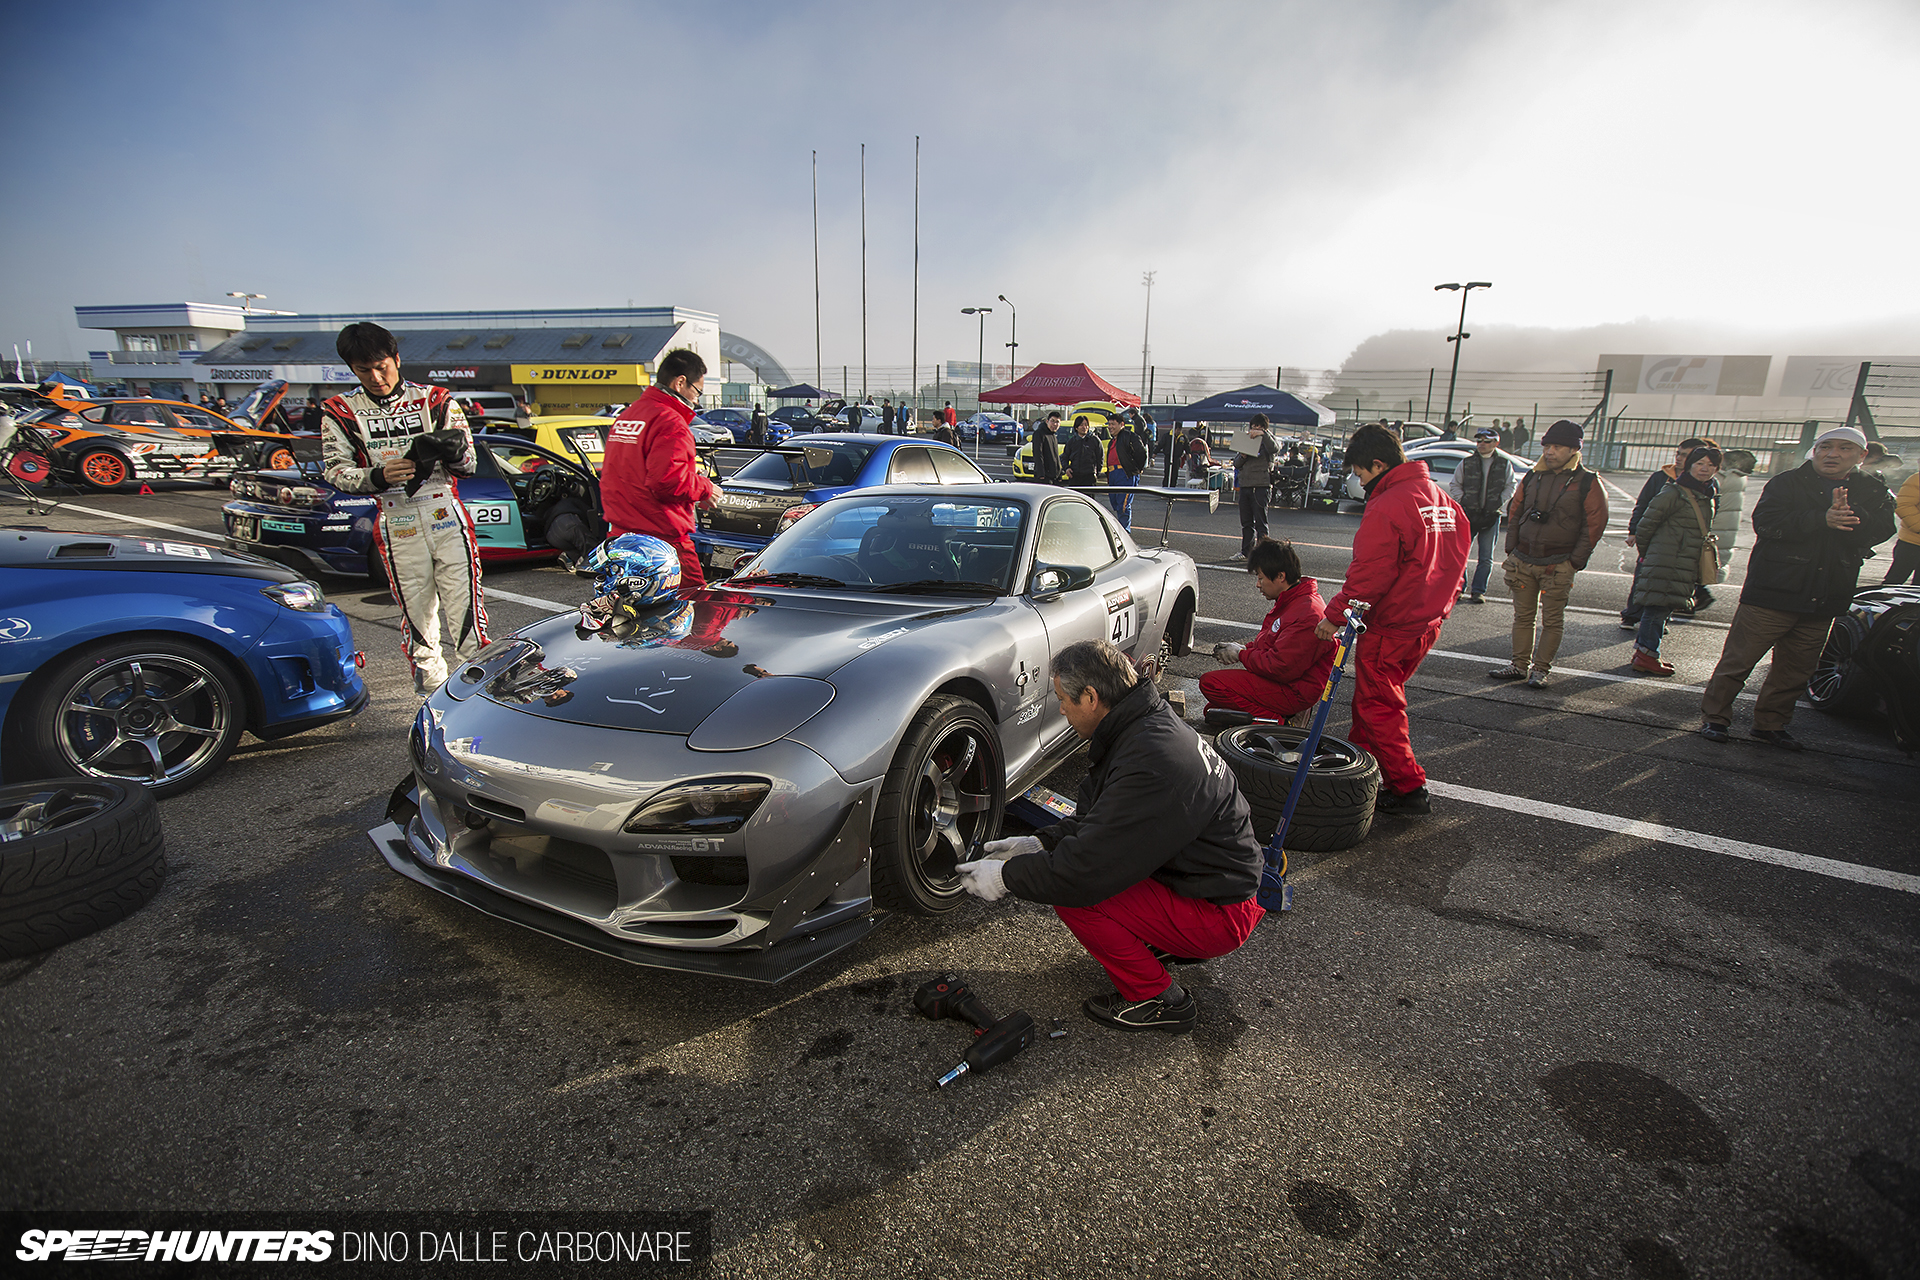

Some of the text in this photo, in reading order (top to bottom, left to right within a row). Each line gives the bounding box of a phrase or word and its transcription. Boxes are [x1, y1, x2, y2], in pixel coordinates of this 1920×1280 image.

[210, 368, 273, 380] BRIDGESTONE
[428, 369, 476, 379] ADVAN
[541, 369, 618, 380] DUNLOP
[354, 402, 422, 416] ADVAN
[367, 413, 422, 432] HKS
[581, 440, 596, 450] 51
[729, 494, 761, 509] Design.
[477, 508, 502, 522] 29
[908, 542, 940, 552] BRIDE
[1112, 611, 1129, 643] 41
[691, 838, 725, 852] GT
